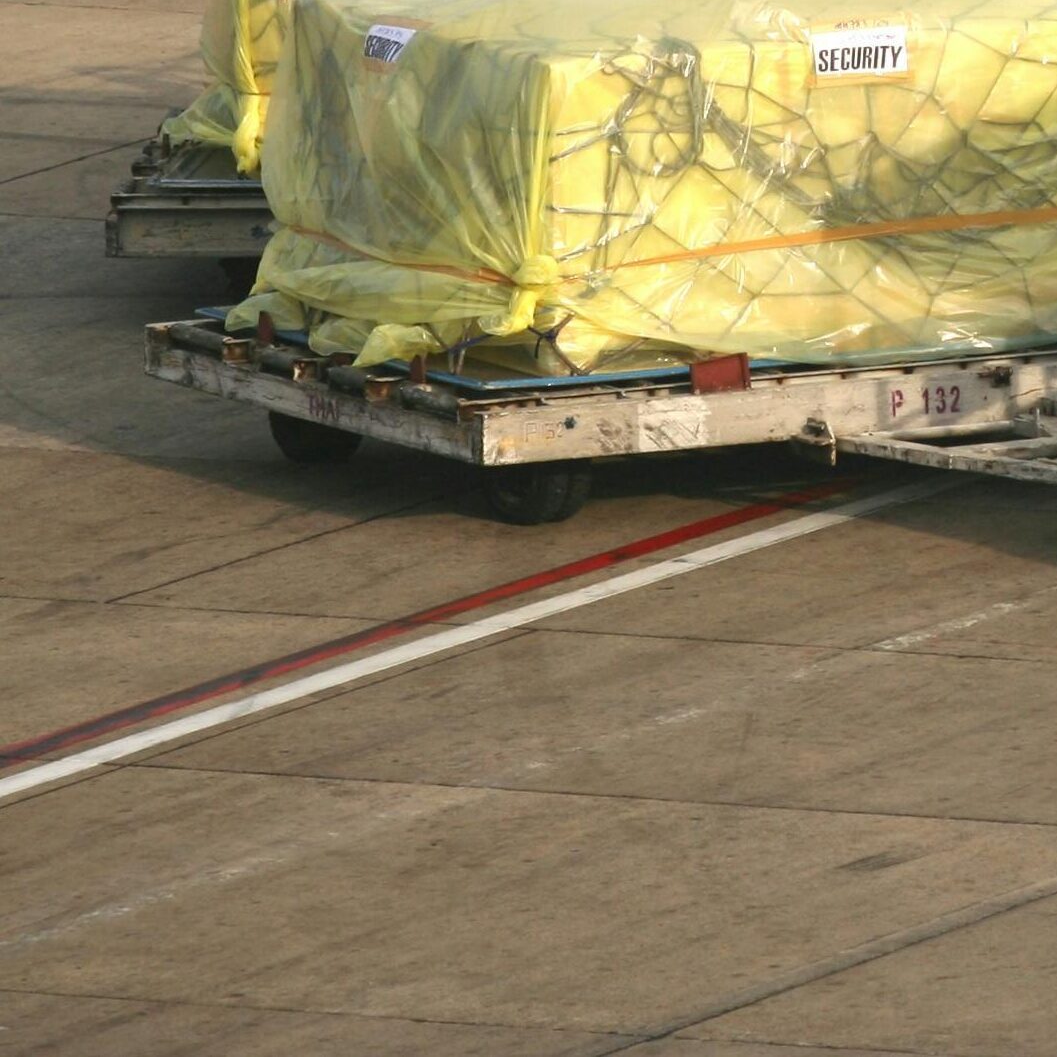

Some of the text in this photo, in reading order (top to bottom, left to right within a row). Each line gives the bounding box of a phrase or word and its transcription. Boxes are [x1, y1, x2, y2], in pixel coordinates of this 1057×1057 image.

[818, 45, 903, 72] SECURITY
[891, 385, 960, 417] P 132
